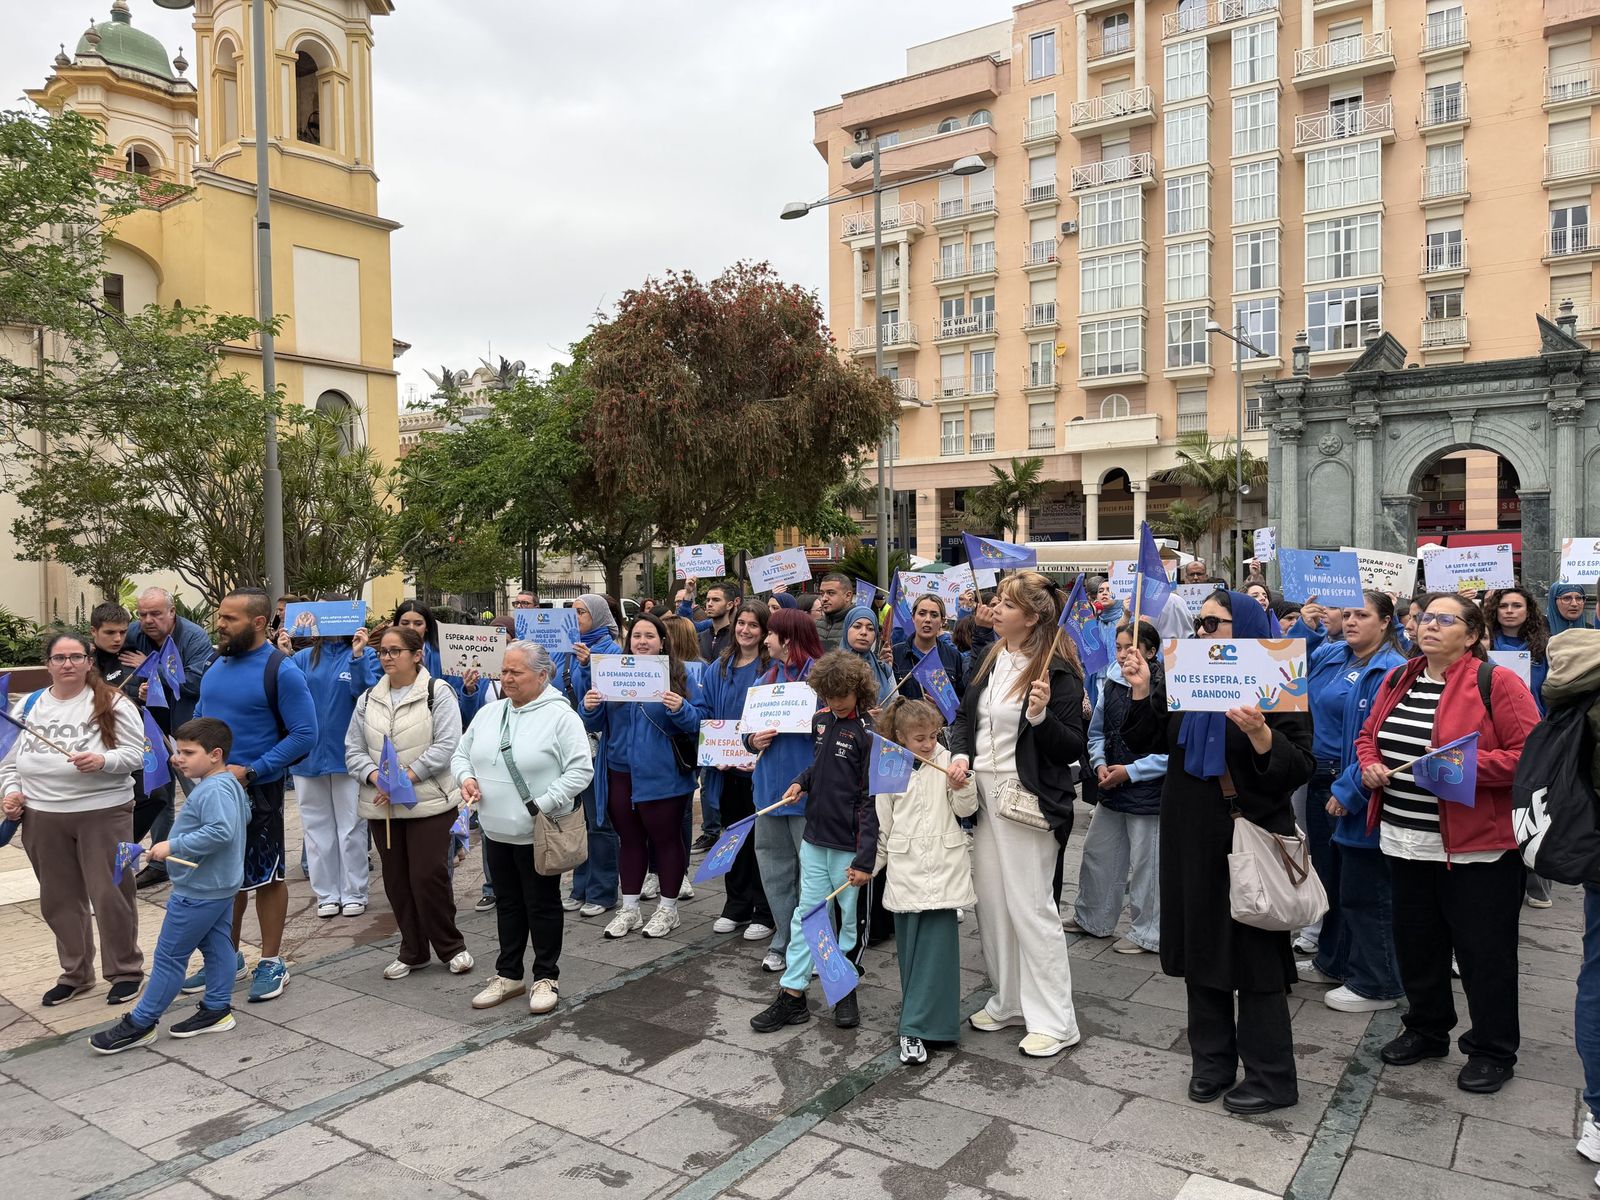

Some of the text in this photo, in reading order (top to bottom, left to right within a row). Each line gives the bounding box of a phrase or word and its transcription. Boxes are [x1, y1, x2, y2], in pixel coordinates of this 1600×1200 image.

[954, 316, 978, 325] VENDE
[762, 563, 796, 576] AUTISMO
[1374, 568, 1398, 576] OPCIÓN
[1306, 588, 1322, 596] LISTA
[1332, 588, 1356, 597] ESPERA
[465, 644, 494, 652] OPCIÓN
[1174, 675, 1256, 685] NO ES ESPERA, ES
[1191, 690, 1240, 699] ABANDONO
